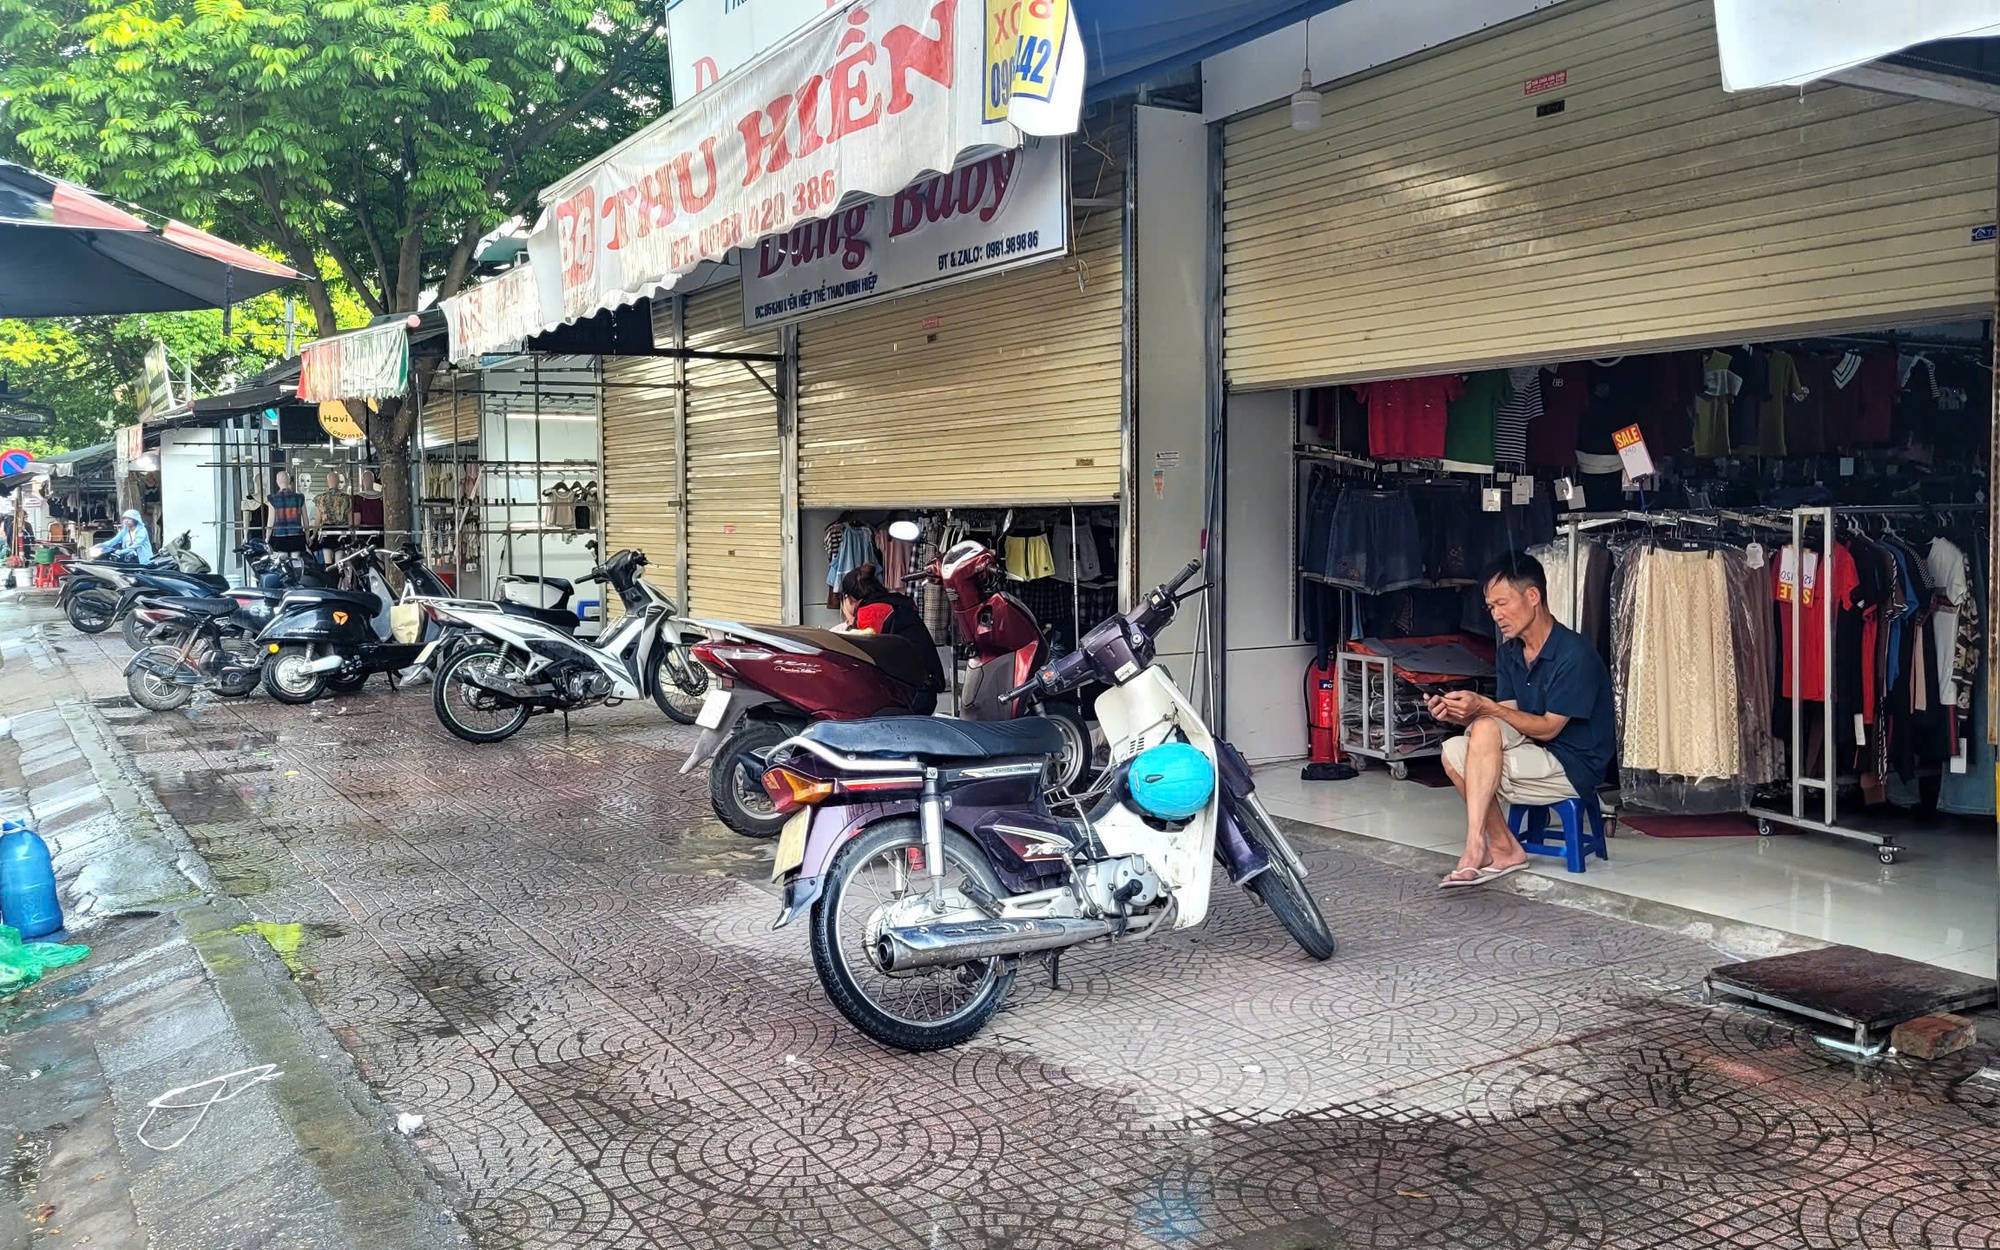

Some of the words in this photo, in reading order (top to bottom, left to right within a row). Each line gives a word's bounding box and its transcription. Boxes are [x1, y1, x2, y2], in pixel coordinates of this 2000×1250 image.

[601, 136, 716, 250] THU
[749, 192, 785, 232] 420
[792, 169, 835, 216] 386
[938, 254, 948, 271] ĐT
[950, 250, 957, 267] &
[958, 246, 983, 266] ZALO:
[799, 288, 811, 311] HIỆP
[813, 279, 826, 304] THỂ
[827, 283, 844, 300] THAO
[846, 279, 860, 296] NINH
[862, 270, 877, 296] HIỆP
[324, 415, 348, 423] Havi
[1615, 427, 1640, 448] SALE
[1779, 583, 1810, 604] SE
